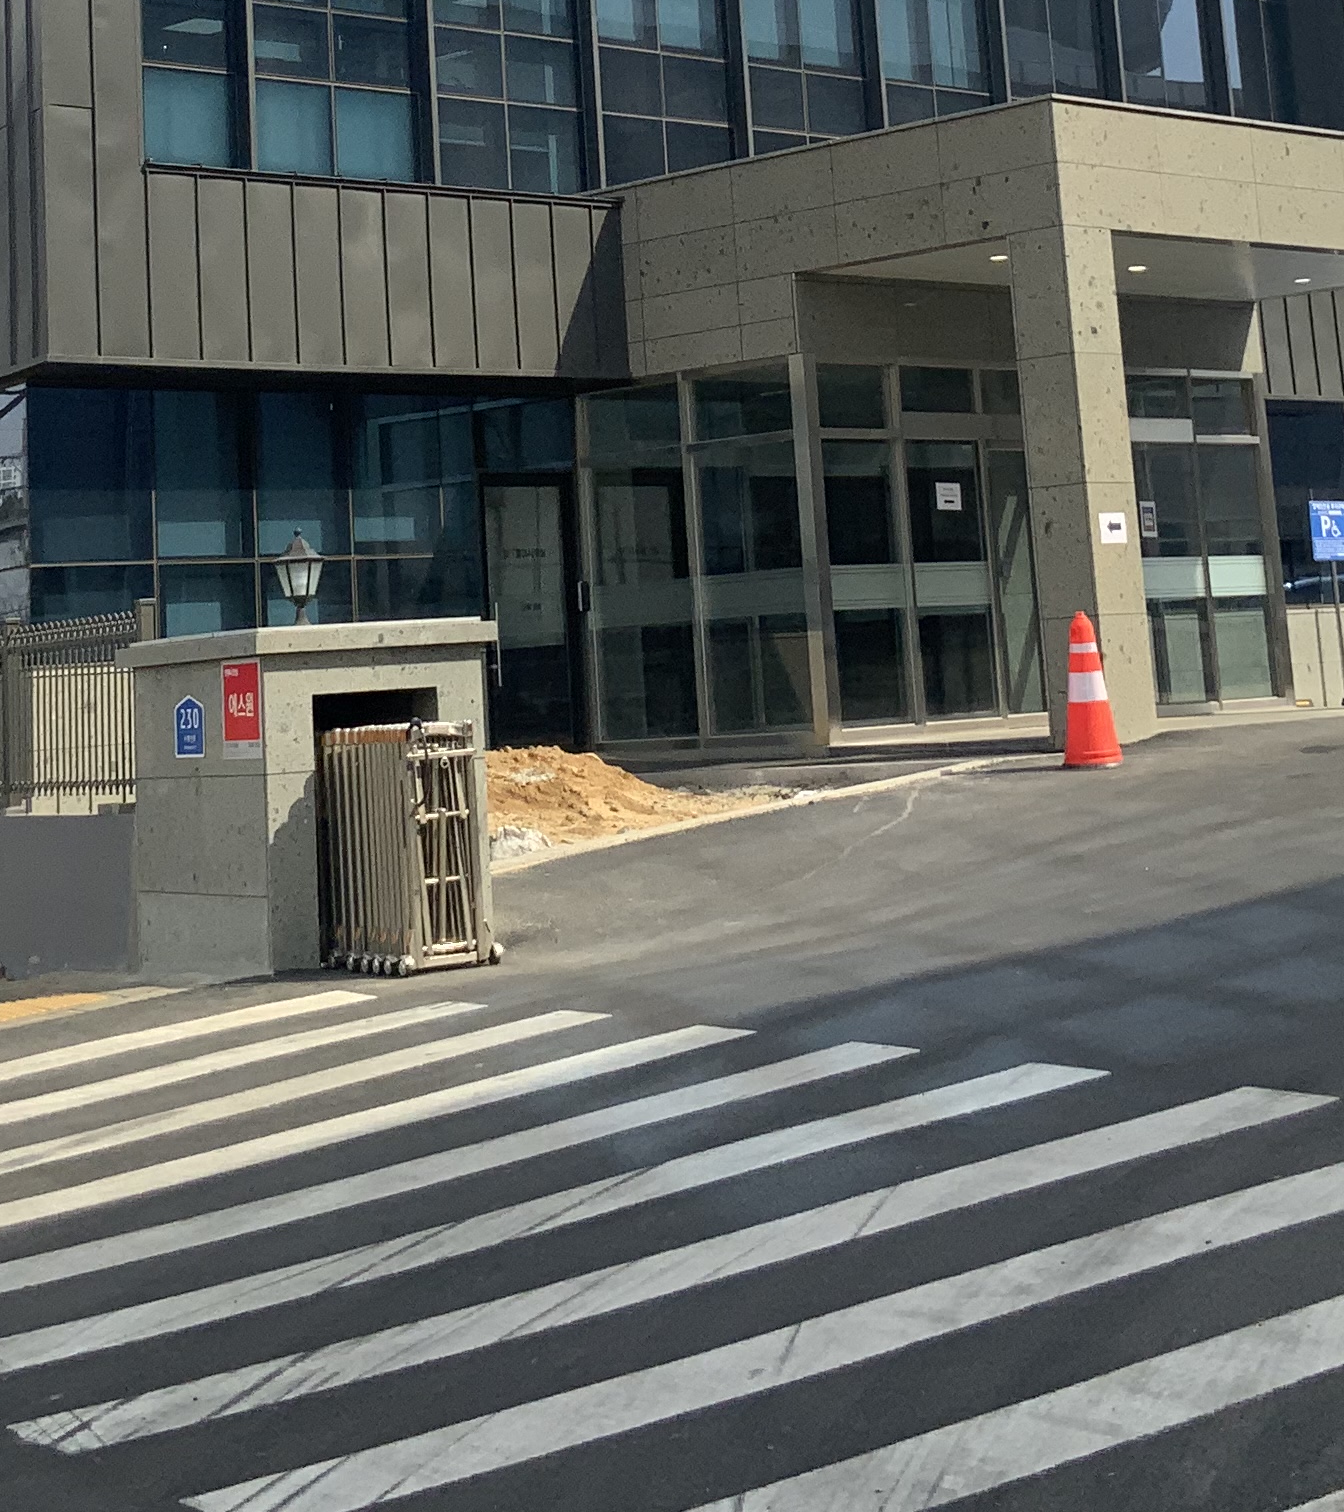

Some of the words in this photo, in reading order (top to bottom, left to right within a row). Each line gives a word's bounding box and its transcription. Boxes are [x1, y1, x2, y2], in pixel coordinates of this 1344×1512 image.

[1320, 515, 1331, 538] P
[228, 692, 255, 718] 에스원
[180, 708, 199, 729] 230
